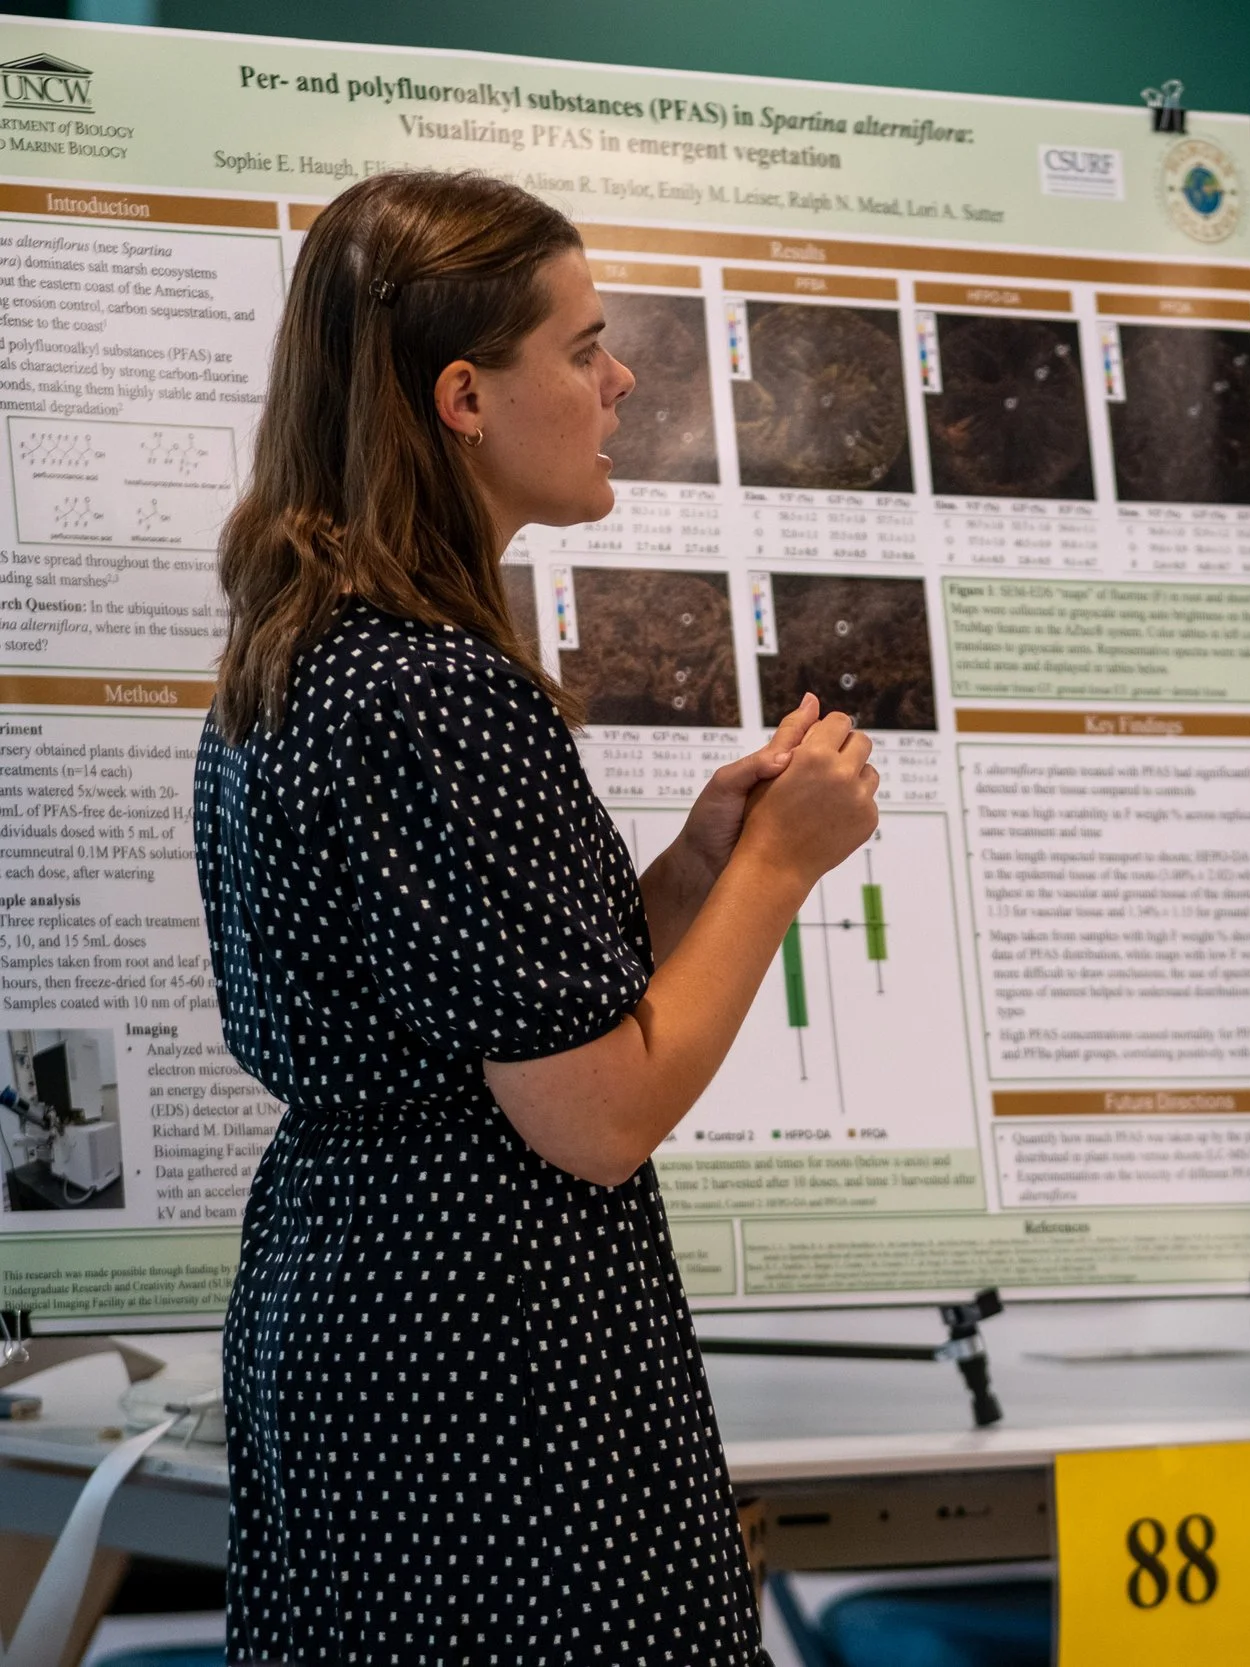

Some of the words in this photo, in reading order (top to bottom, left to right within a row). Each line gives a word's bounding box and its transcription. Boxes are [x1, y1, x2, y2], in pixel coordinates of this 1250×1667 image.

[1, 74, 92, 104] UNCW
[239, 65, 289, 90] Per-
[296, 73, 338, 94] and
[348, 75, 521, 114] polyfluoroalkyl
[527, 89, 643, 118] substances
[649, 99, 727, 130] (PFAS)
[734, 104, 753, 126] in
[760, 106, 847, 135] Spartina
[853, 113, 974, 146] alterniflora:
[58, 120, 72, 136] of
[75, 121, 135, 139] BIOLOGY
[10, 137, 65, 153] MARINE
[68, 141, 128, 159] BIOLOGY
[399, 114, 524, 148] Visualizing
[531, 123, 592, 150] PFAS
[600, 130, 620, 152] in
[627, 135, 727, 162] emergent
[733, 144, 841, 170] vegetation
[214, 150, 272, 174] Sophie
[277, 154, 294, 173] E.
[300, 157, 358, 179] Haugh,
[1044, 149, 1113, 174] CSURF
[524, 173, 575, 192] Alison
[580, 176, 596, 193] R.
[602, 177, 653, 201] Taylor,
[658, 181, 703, 205] Emily
[788, 191, 832, 214] Ralph
[907, 199, 938, 218] Lori
[47, 193, 150, 218] Introduction
[16, 234, 88, 253] alterniflorus
[122, 242, 172, 258] Spartina
[770, 241, 826, 263] Results
[25, 257, 84, 272] dominates
[88, 260, 108, 273] salt
[112, 262, 147, 275] marsh
[151, 266, 217, 280] ecosystems
[18, 275, 36, 288] the
[39, 278, 81, 290] eastern
[85, 280, 114, 293] coast
[118, 281, 130, 294] of
[134, 283, 151, 296] the
[154, 284, 214, 301] Americas,
[13, 296, 56, 309] erosion
[59, 300, 104, 314] control,
[108, 301, 147, 315] carbon
[151, 305, 231, 321] sequestration,
[234, 309, 255, 321] and
[9, 339, 99, 357] polyfluoroalkyl
[103, 346, 165, 360] substances
[168, 347, 211, 364] (PFAS)
[215, 353, 232, 363] are
[20, 361, 98, 376] characterized
[101, 364, 115, 379] by
[119, 368, 155, 381] strong
[159, 369, 248, 384] carbon-fluorine
[39, 382, 82, 398] making
[86, 383, 114, 396] them
[118, 385, 154, 401] highly
[158, 387, 192, 400] stable
[196, 389, 215, 401] and
[12, 553, 40, 565] have
[44, 553, 82, 568] spread
[86, 555, 149, 571] throughout
[153, 557, 170, 569] the
[26, 598, 87, 613] Question:
[91, 601, 103, 612] In
[106, 602, 124, 613] the
[128, 603, 188, 617] ubiquitous
[192, 605, 212, 616] salt
[20, 618, 92, 634] alterniflora,
[95, 621, 130, 633] where
[135, 622, 146, 634] in
[149, 623, 167, 635] the
[170, 624, 209, 637] tissues
[5, 639, 48, 651] stored?
[105, 684, 177, 704] Methods
[1084, 712, 1115, 736] Key
[1119, 713, 1184, 737] Findings
[35, 745, 86, 757] obtained
[90, 746, 124, 760] plants
[128, 747, 171, 759] divided
[62, 766, 97, 779] (n=14
[101, 767, 132, 781] each)
[28, 785, 74, 797] watered
[78, 785, 126, 798] 5x/week
[131, 787, 156, 798] with
[160, 787, 179, 799] 20-
[61, 825, 95, 838] dosed
[99, 826, 124, 838] with
[128, 827, 135, 838] 5
[139, 827, 158, 839] mL
[162, 827, 175, 839] of
[6, 865, 33, 878] each
[38, 865, 70, 880] dose,
[73, 866, 100, 879] after
[104, 868, 155, 882] watering
[30, 893, 81, 909] analysis
[39, 914, 96, 929] replicates
[99, 914, 113, 927] of
[115, 914, 142, 927] each
[146, 916, 200, 927] treatment
[126, 1023, 178, 1038] Imaging
[146, 1042, 202, 1057] Analyzed
[151, 1103, 189, 1119] (EDS)
[193, 1103, 242, 1116] detector
[243, 1105, 252, 1115] at
[1105, 1093, 1152, 1111] Future
[1157, 1093, 1235, 1110] Directions
[152, 1124, 199, 1138] Richard
[203, 1124, 220, 1137] M.
[157, 1206, 175, 1220] kV
[180, 1206, 200, 1218] and
[205, 1205, 236, 1218] beam
[1126, 1513, 1219, 1611] 88
